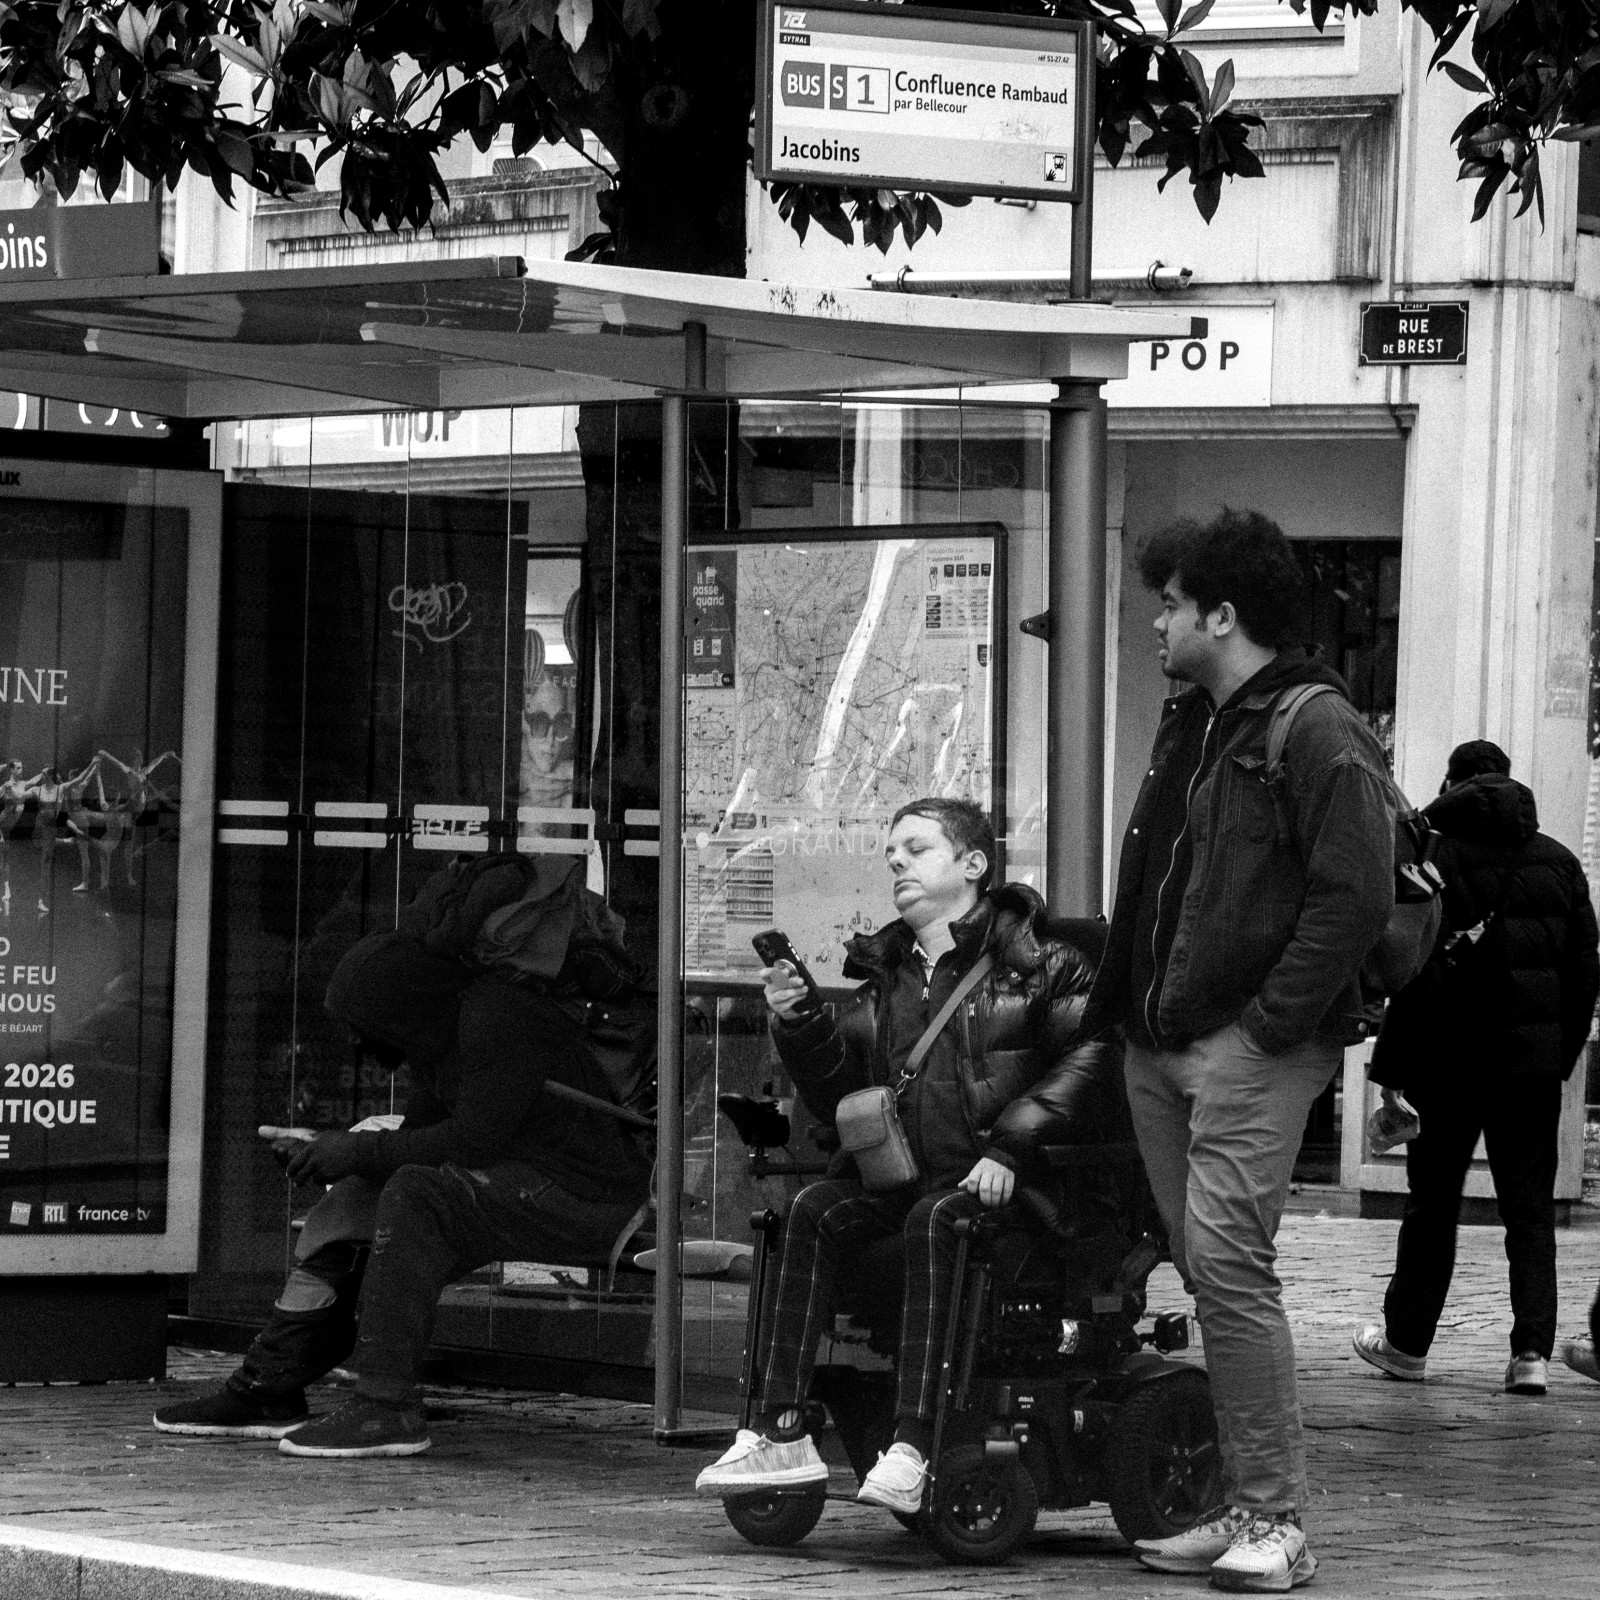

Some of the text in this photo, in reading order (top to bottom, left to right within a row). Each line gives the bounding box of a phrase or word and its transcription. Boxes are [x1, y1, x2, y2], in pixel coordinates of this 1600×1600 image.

[783, 11, 807, 29] TCL
[782, 35, 807, 44] SYTRAL
[787, 73, 821, 96] BUS
[894, 70, 1068, 105] Confluence Rambaud
[894, 97, 968, 114] par Bellecour
[780, 136, 860, 162] Jacobins
[1399, 318, 1429, 334] RUE
[1383, 338, 1443, 354] DE BREST
[1150, 341, 1240, 371] POP
[693, 585, 719, 599] passe
[696, 593, 725, 610] quand
[13, 966, 57, 985] FEU
[10, 1021, 43, 1033] BÉJART
[4, 1063, 75, 1088] 2026
[44, 1205, 66, 1222] RTL
[77, 1205, 129, 1221] france
